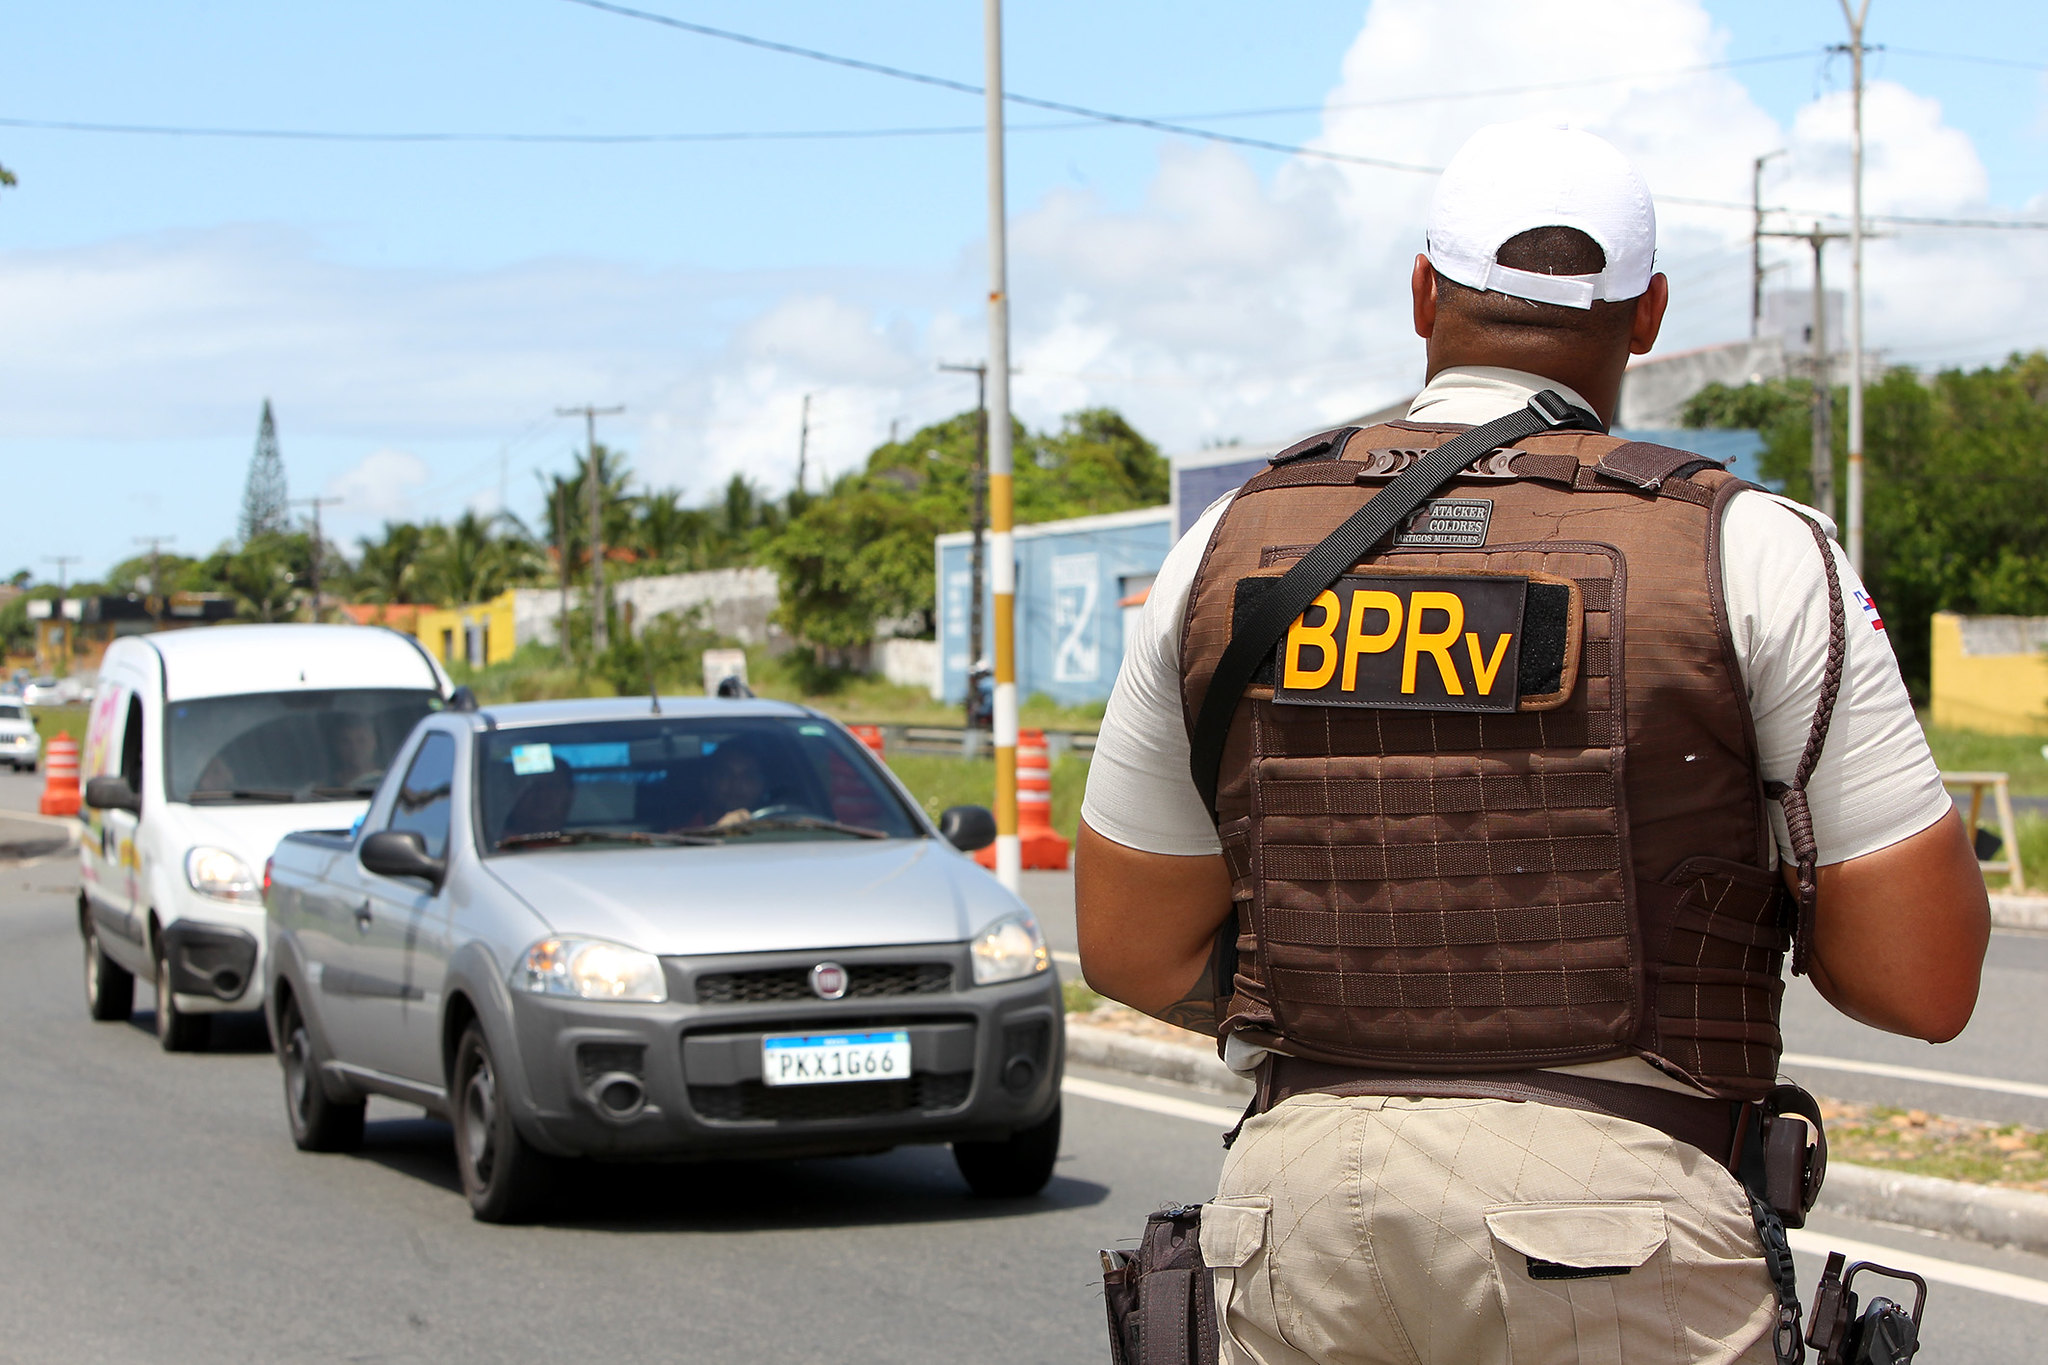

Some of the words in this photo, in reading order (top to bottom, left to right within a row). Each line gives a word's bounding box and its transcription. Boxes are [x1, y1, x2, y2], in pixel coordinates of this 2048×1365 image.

[1431, 505, 1487, 518] ATACKER
[1429, 519, 1483, 532] COLDRES
[1397, 534, 1432, 544] ARTIGOS
[1433, 534, 1478, 544] MILITARES
[1283, 589, 1513, 696] BPRv
[780, 1049, 894, 1078] PKX1G66
